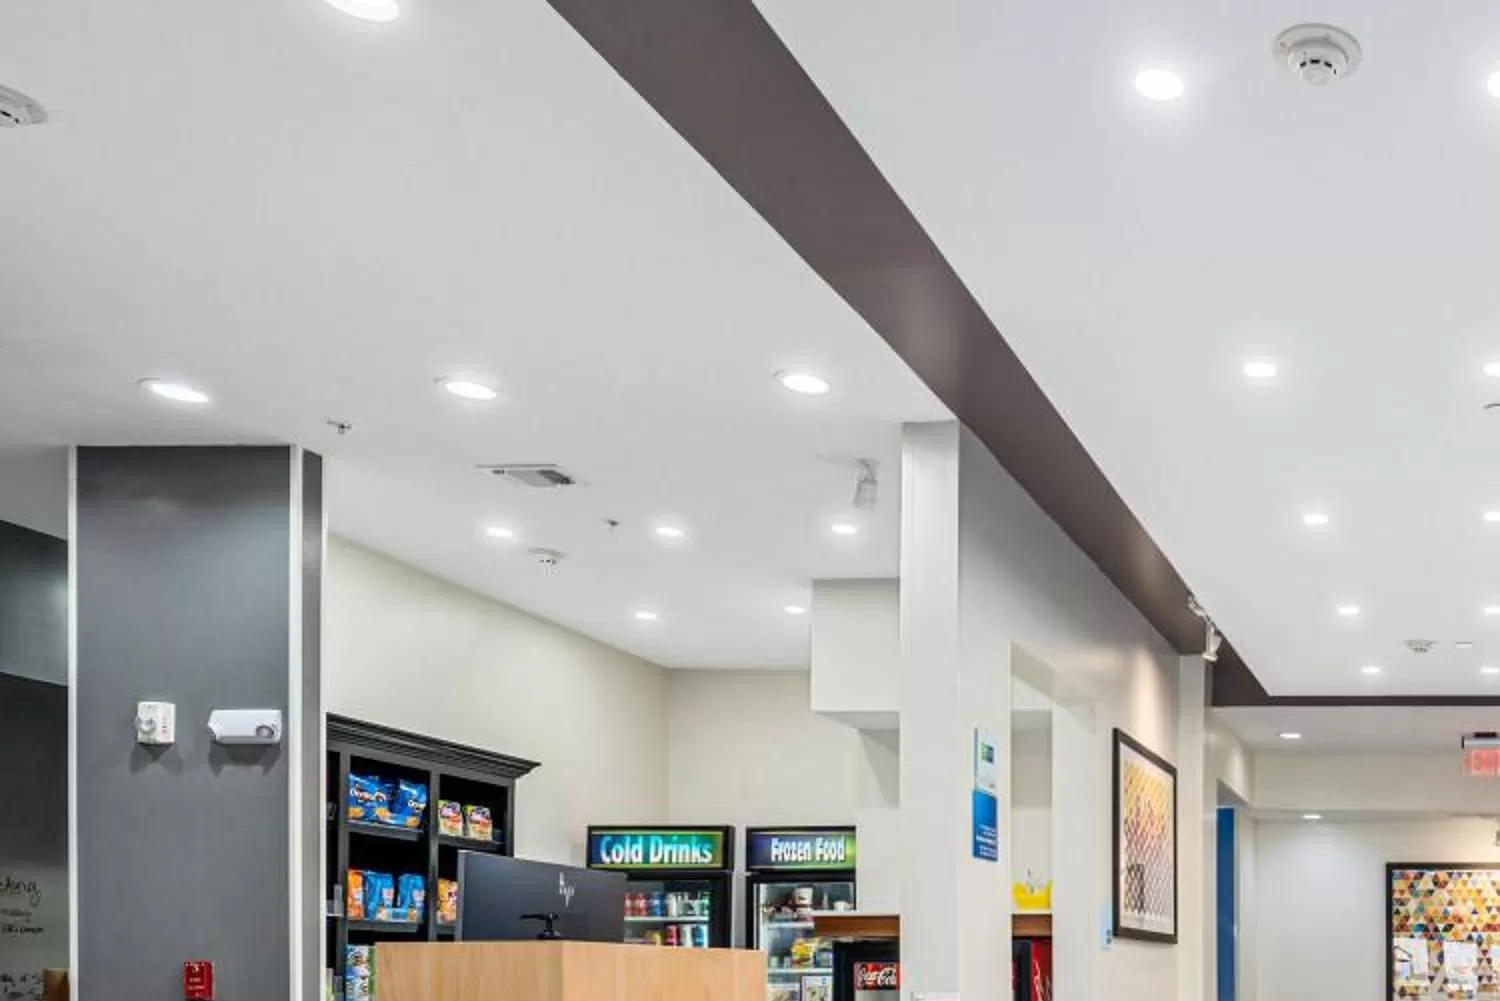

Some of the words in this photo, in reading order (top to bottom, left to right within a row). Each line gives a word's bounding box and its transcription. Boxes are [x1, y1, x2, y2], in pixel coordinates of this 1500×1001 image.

[601, 835, 644, 864] Cold
[649, 834, 713, 864] Drinks
[771, 837, 812, 862] Frozen
[815, 836, 845, 861] Food
